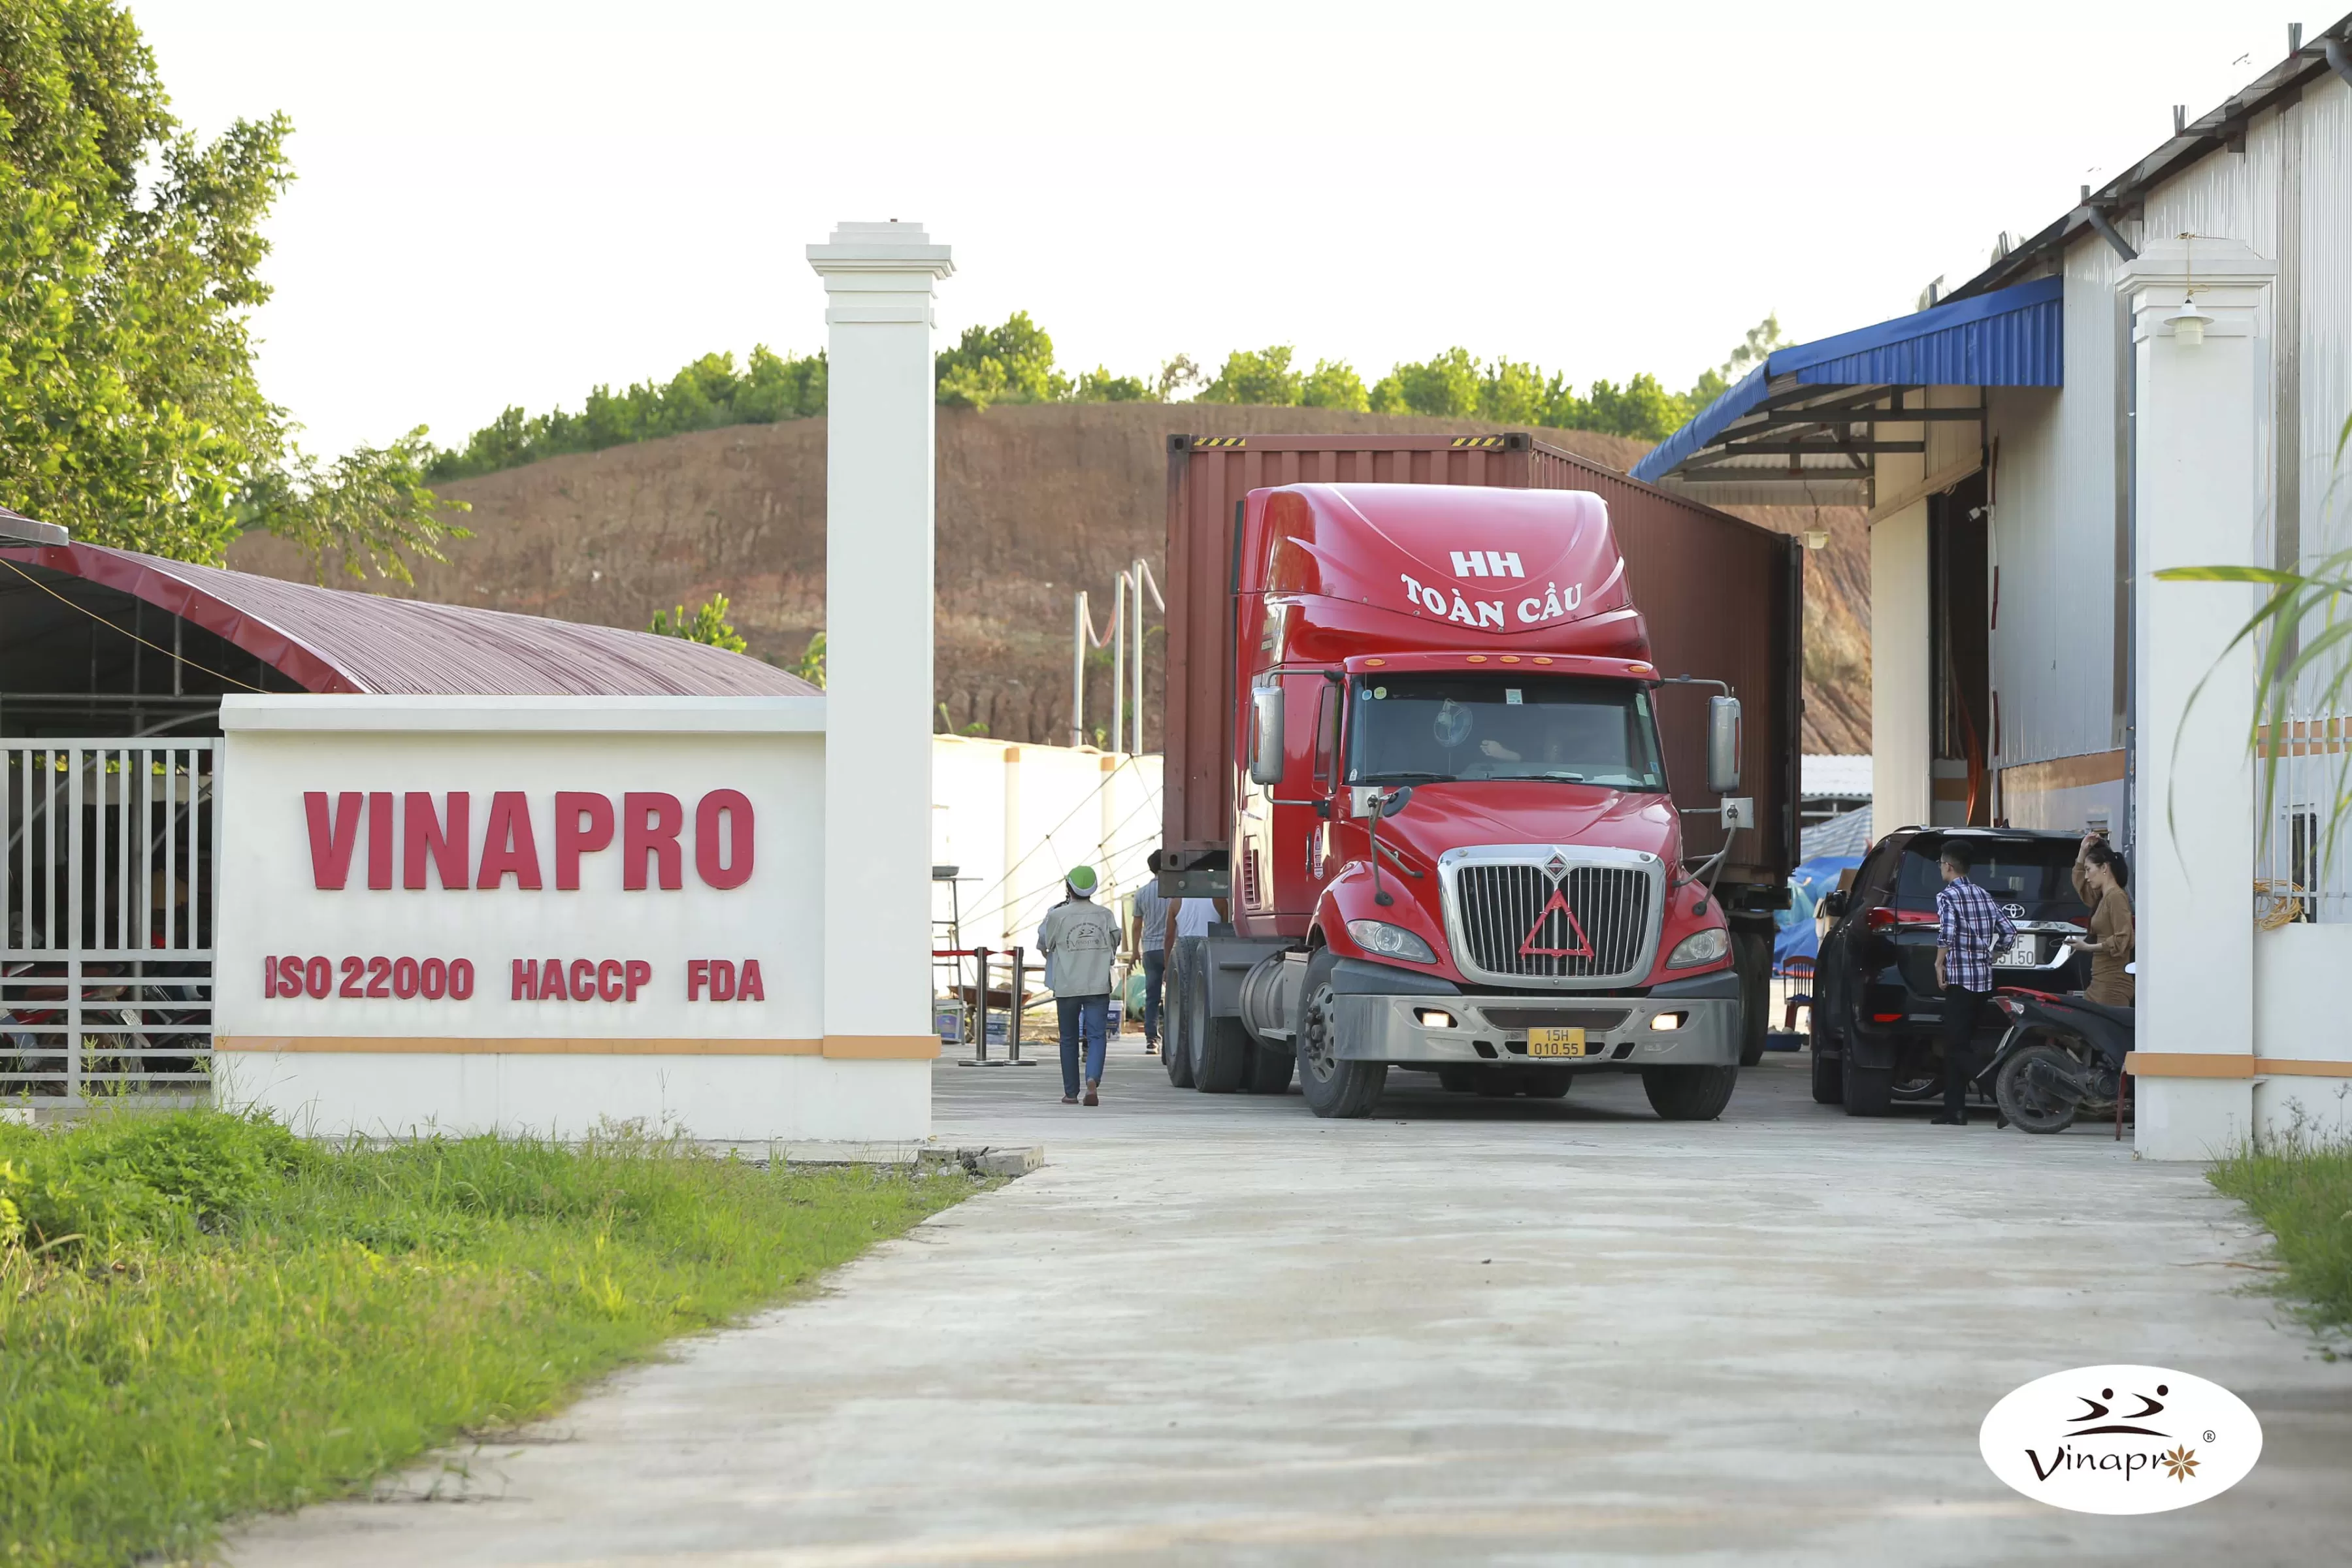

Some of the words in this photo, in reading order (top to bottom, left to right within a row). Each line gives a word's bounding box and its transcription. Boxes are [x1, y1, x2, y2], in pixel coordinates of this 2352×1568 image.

[1449, 551, 1526, 578] HH
[1400, 573, 1506, 627] TOÀN
[1516, 581, 1582, 624] CẦU
[303, 789, 755, 890] VINAPRO
[265, 955, 332, 999] ISO
[339, 955, 475, 1001] 22000
[512, 958, 652, 1002] HACCP
[687, 959, 765, 1002] FDA
[1534, 1043, 1578, 1055] 010.55
[1546, 1030, 1569, 1041] 15H
